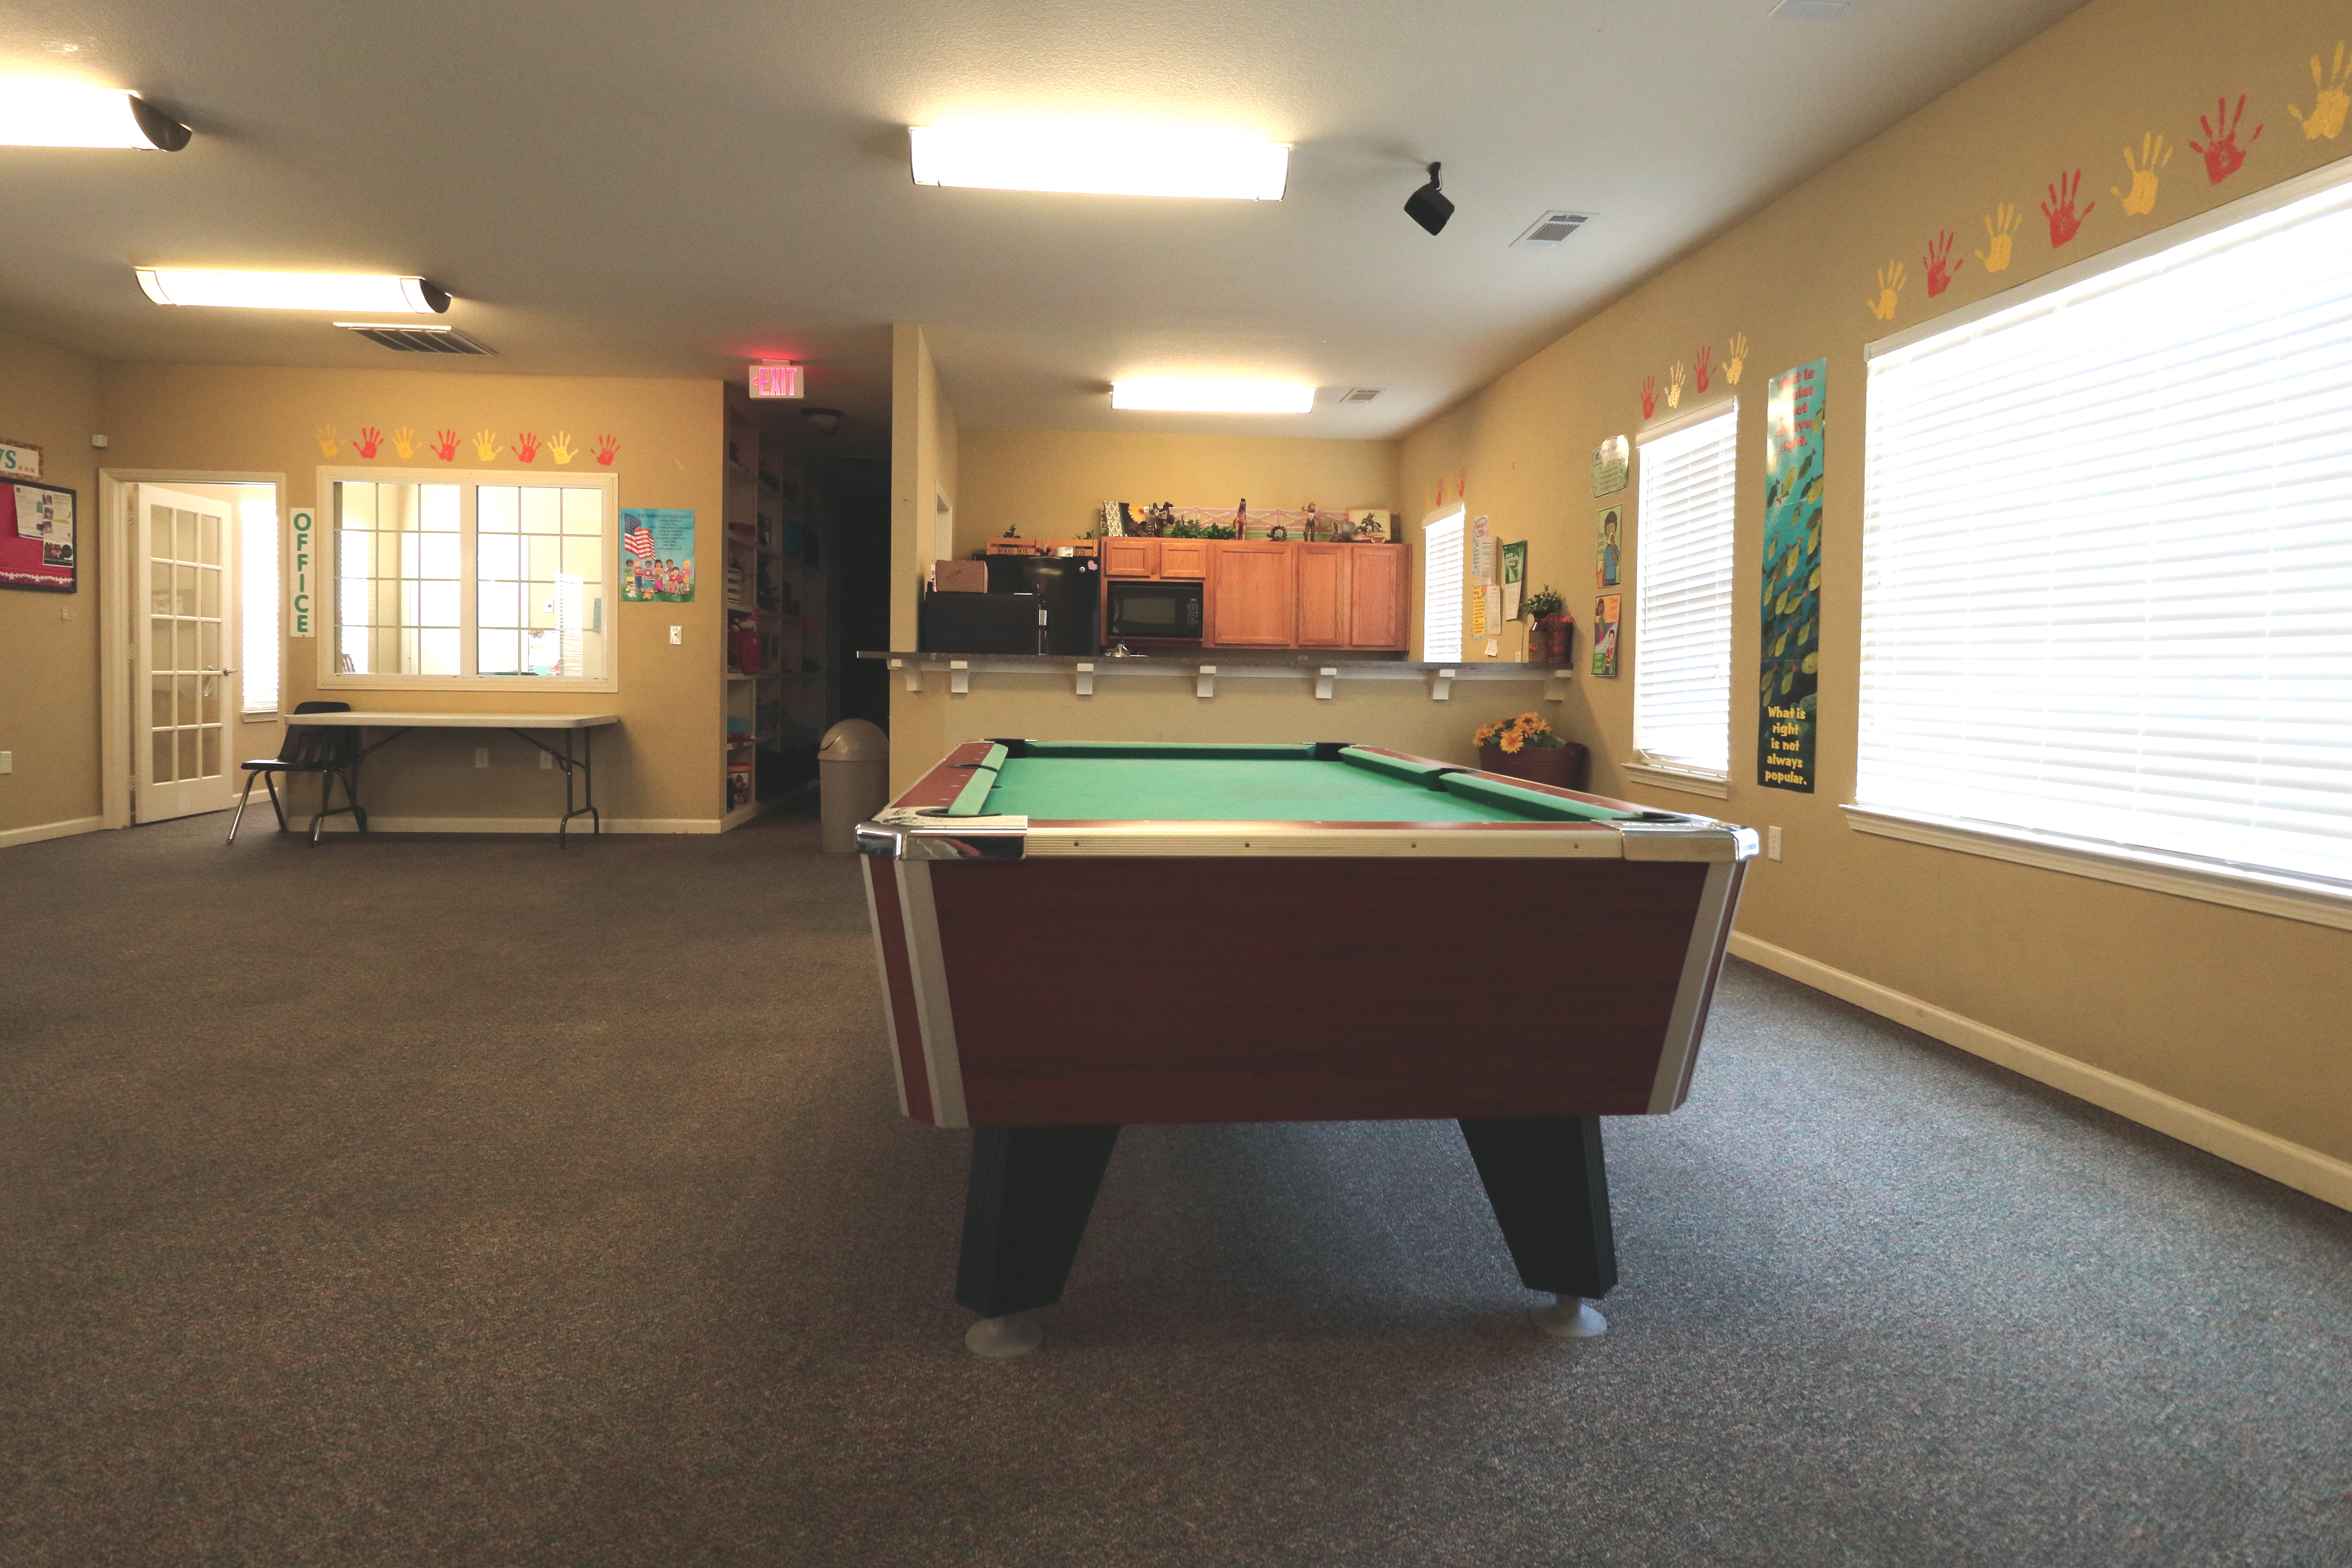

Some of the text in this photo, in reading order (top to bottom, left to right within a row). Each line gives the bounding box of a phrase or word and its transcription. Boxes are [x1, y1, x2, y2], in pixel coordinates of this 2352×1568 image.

[759, 367, 797, 396] EXIT
[1804, 368, 1815, 380] is
[1781, 434, 1809, 453] right.
[294, 513, 312, 632] OFFICE
[1768, 706, 1806, 719] What is
[1773, 722, 1799, 736] right
[1771, 737, 1800, 751] is not
[1767, 753, 1803, 769] always
[1765, 770, 1807, 785] popular.
